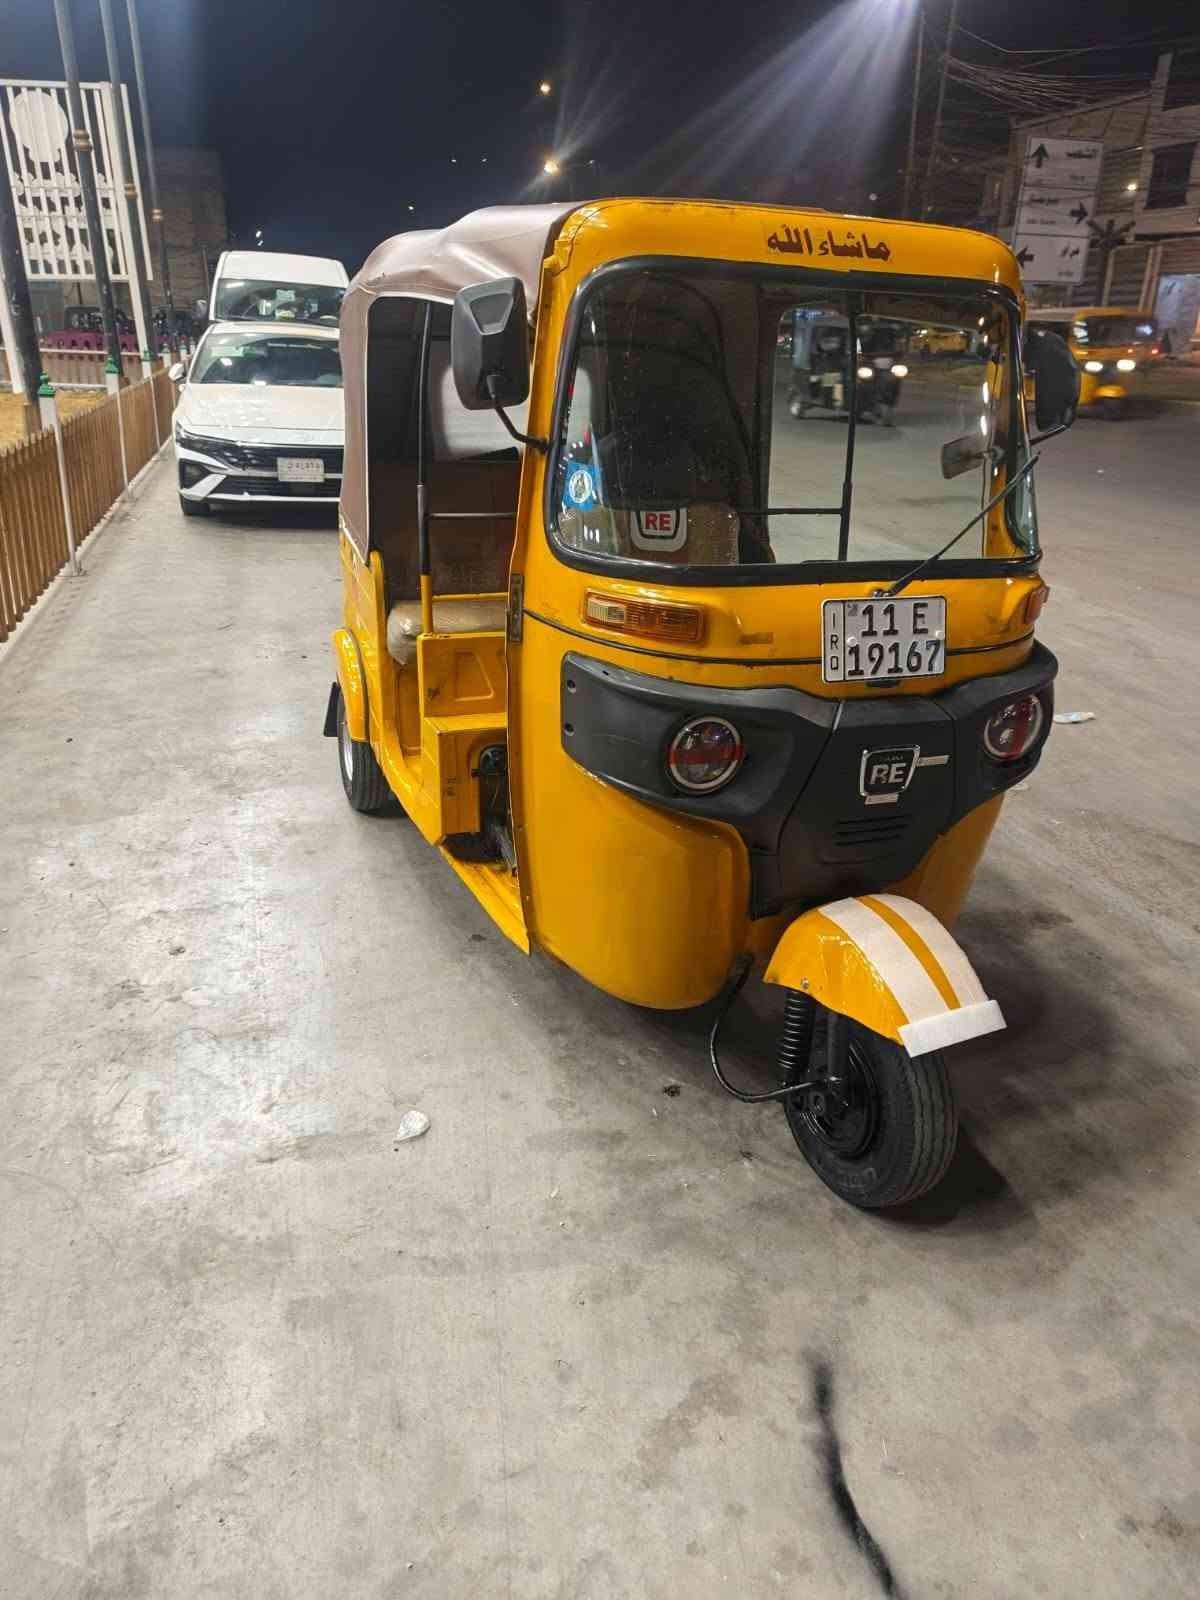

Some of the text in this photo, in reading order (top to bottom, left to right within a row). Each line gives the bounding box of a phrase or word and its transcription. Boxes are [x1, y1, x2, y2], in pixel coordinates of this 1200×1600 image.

[767, 223, 813, 256] الله
[643, 512, 671, 532] RE
[861, 601, 929, 637] 11 E
[847, 639, 942, 676] 19167
[870, 762, 906, 785] RE
